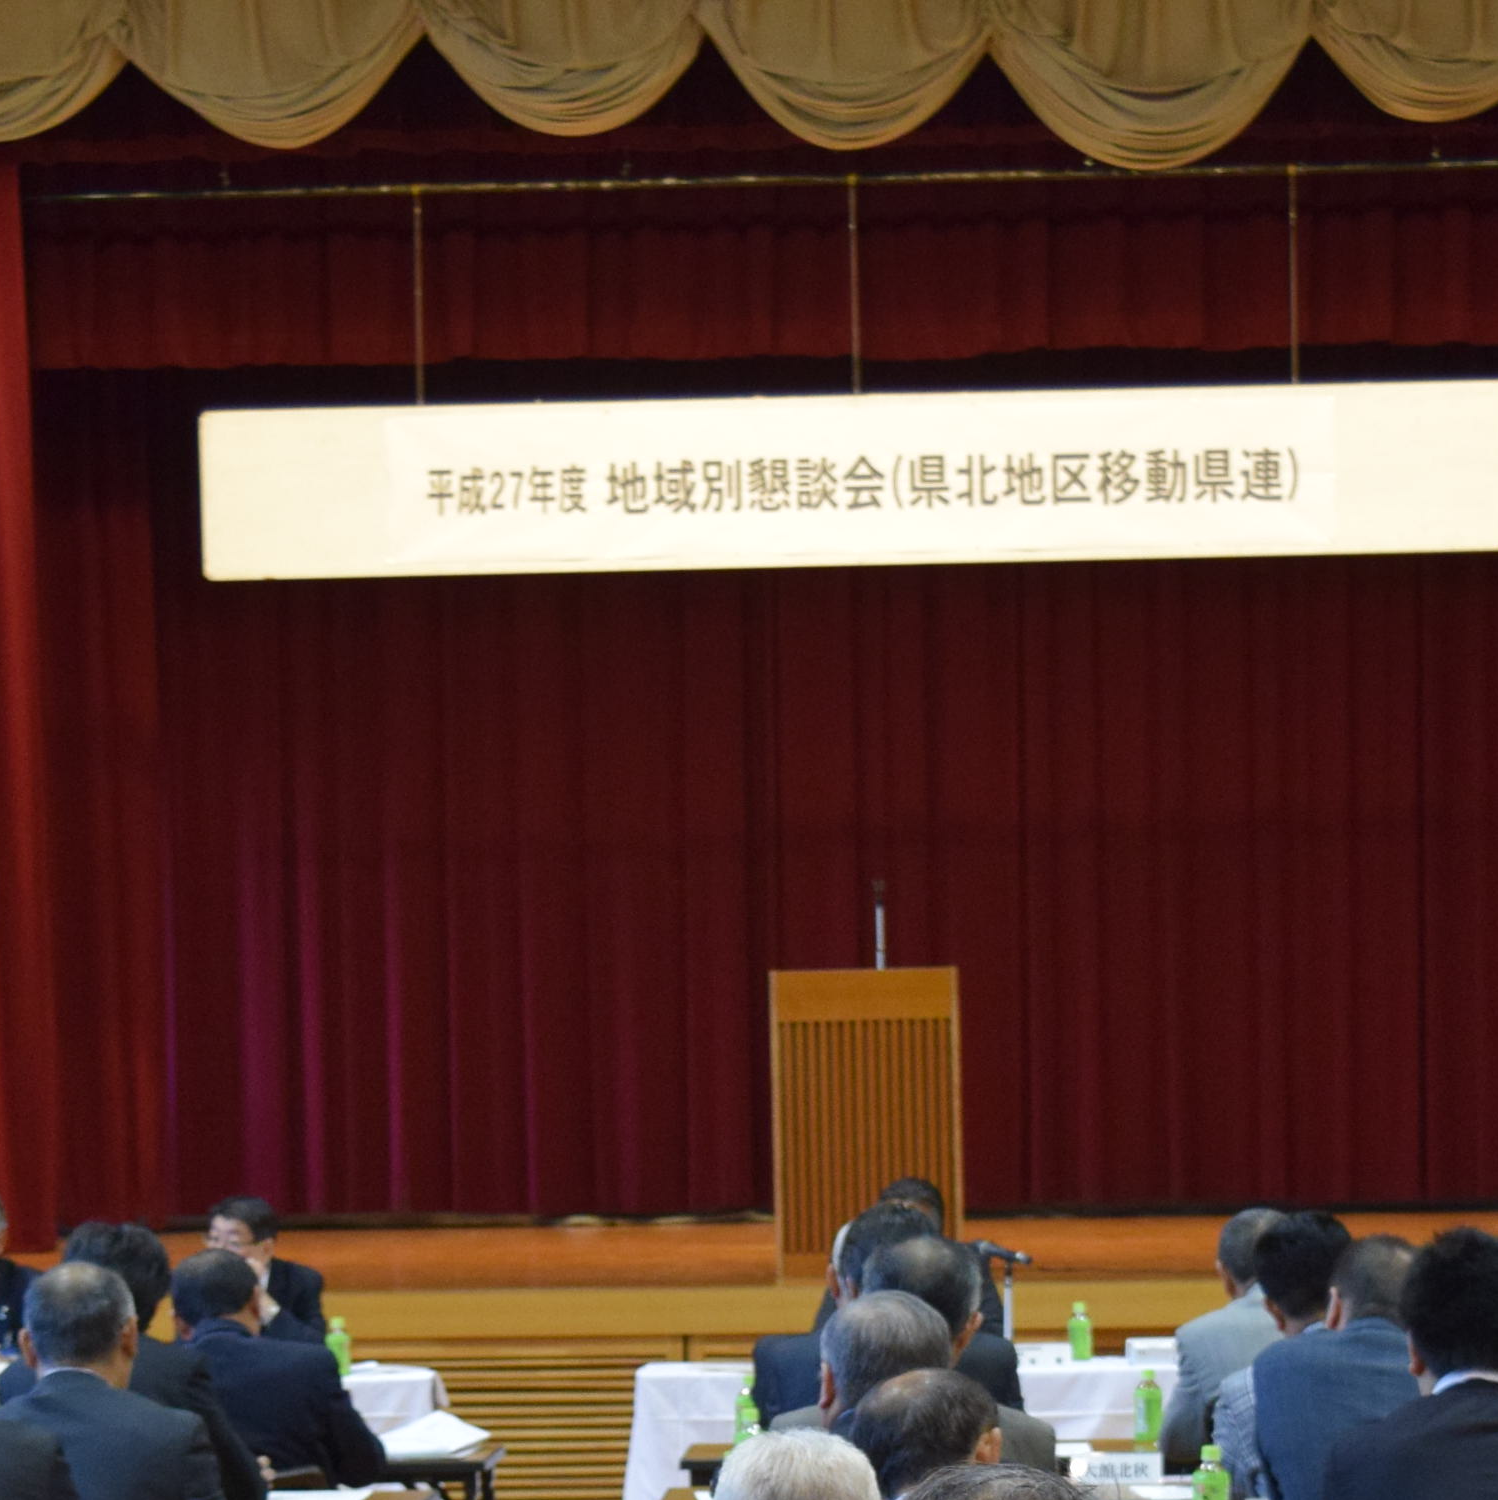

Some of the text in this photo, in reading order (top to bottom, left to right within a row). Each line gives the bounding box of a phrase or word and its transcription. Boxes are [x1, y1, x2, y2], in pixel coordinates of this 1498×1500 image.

[427, 447, 1298, 516] 平成27年度 地域別懇談会(県北地区移動県連)
